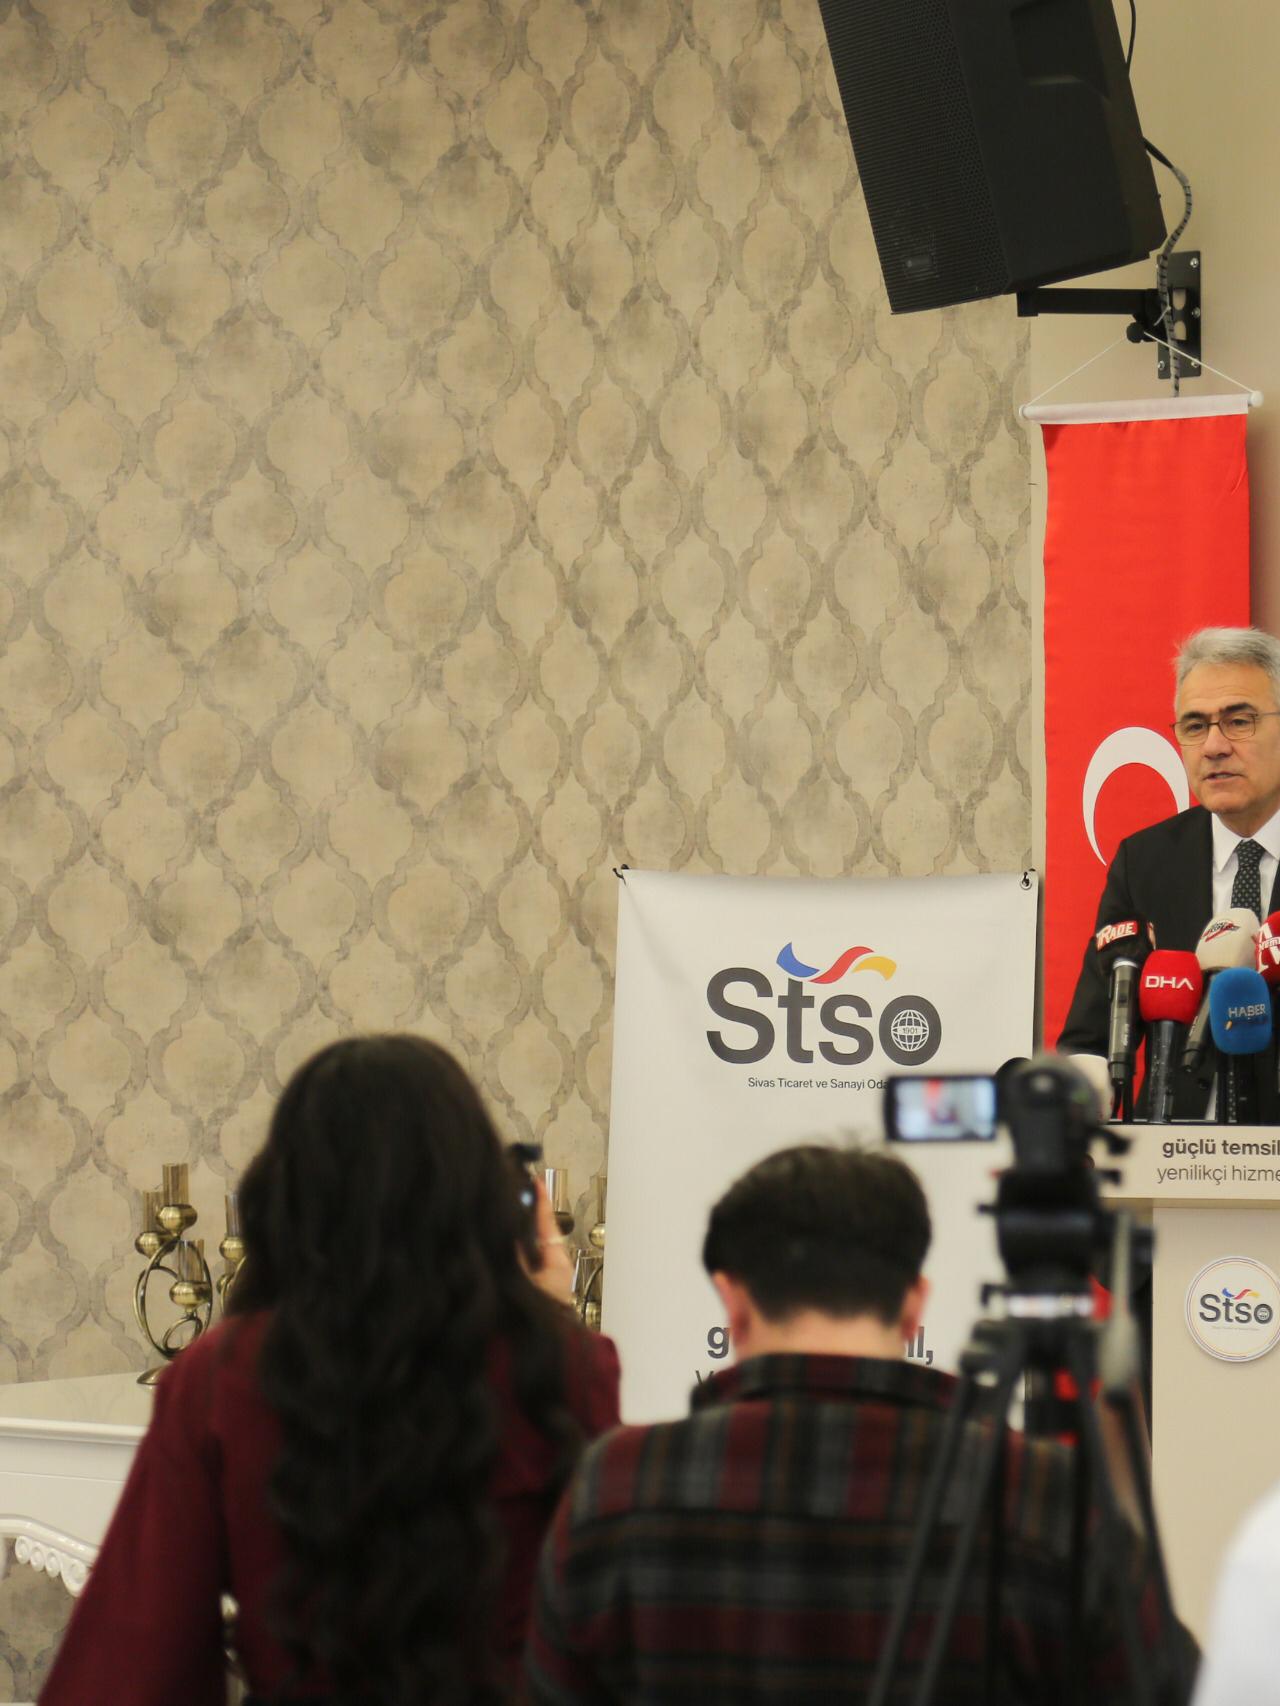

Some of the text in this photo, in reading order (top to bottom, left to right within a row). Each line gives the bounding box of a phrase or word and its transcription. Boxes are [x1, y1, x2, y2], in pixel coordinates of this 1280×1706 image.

[1145, 975, 1194, 991] DHA
[706, 966, 942, 1066] Stso
[1227, 1003, 1266, 1018] HABER
[747, 1077, 888, 1091] Sivas Ticaret ve Sanayi Oda
[1162, 1138, 1216, 1159] güçlü
[1157, 1165, 1227, 1185] yenilikçi
[1199, 1293, 1274, 1324] Stso
